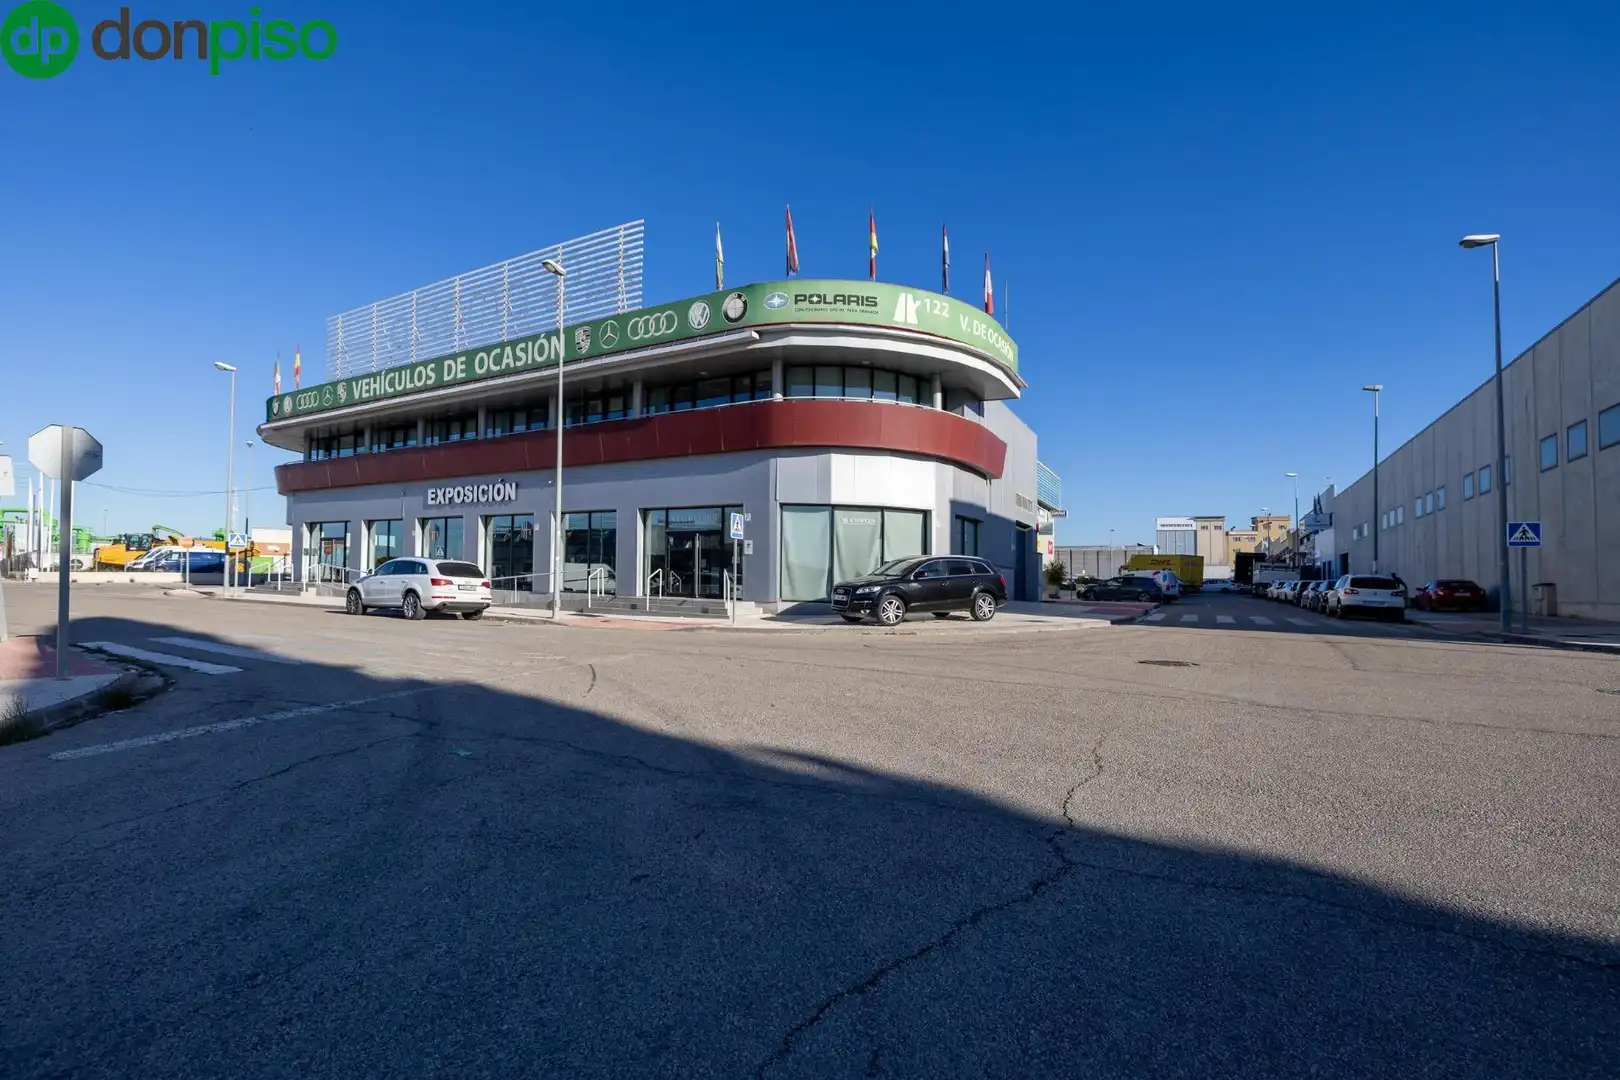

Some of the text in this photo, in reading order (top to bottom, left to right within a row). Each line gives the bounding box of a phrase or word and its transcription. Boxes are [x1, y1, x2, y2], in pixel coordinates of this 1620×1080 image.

[794, 293, 878, 307] POLARIS
[924, 298, 950, 318] 122
[960, 314, 1014, 363] V. DE OCASIÓN
[352, 333, 566, 400] VEHÍCULOS DE OCASIÓN
[427, 478, 517, 505] EXPOSICIÓN
